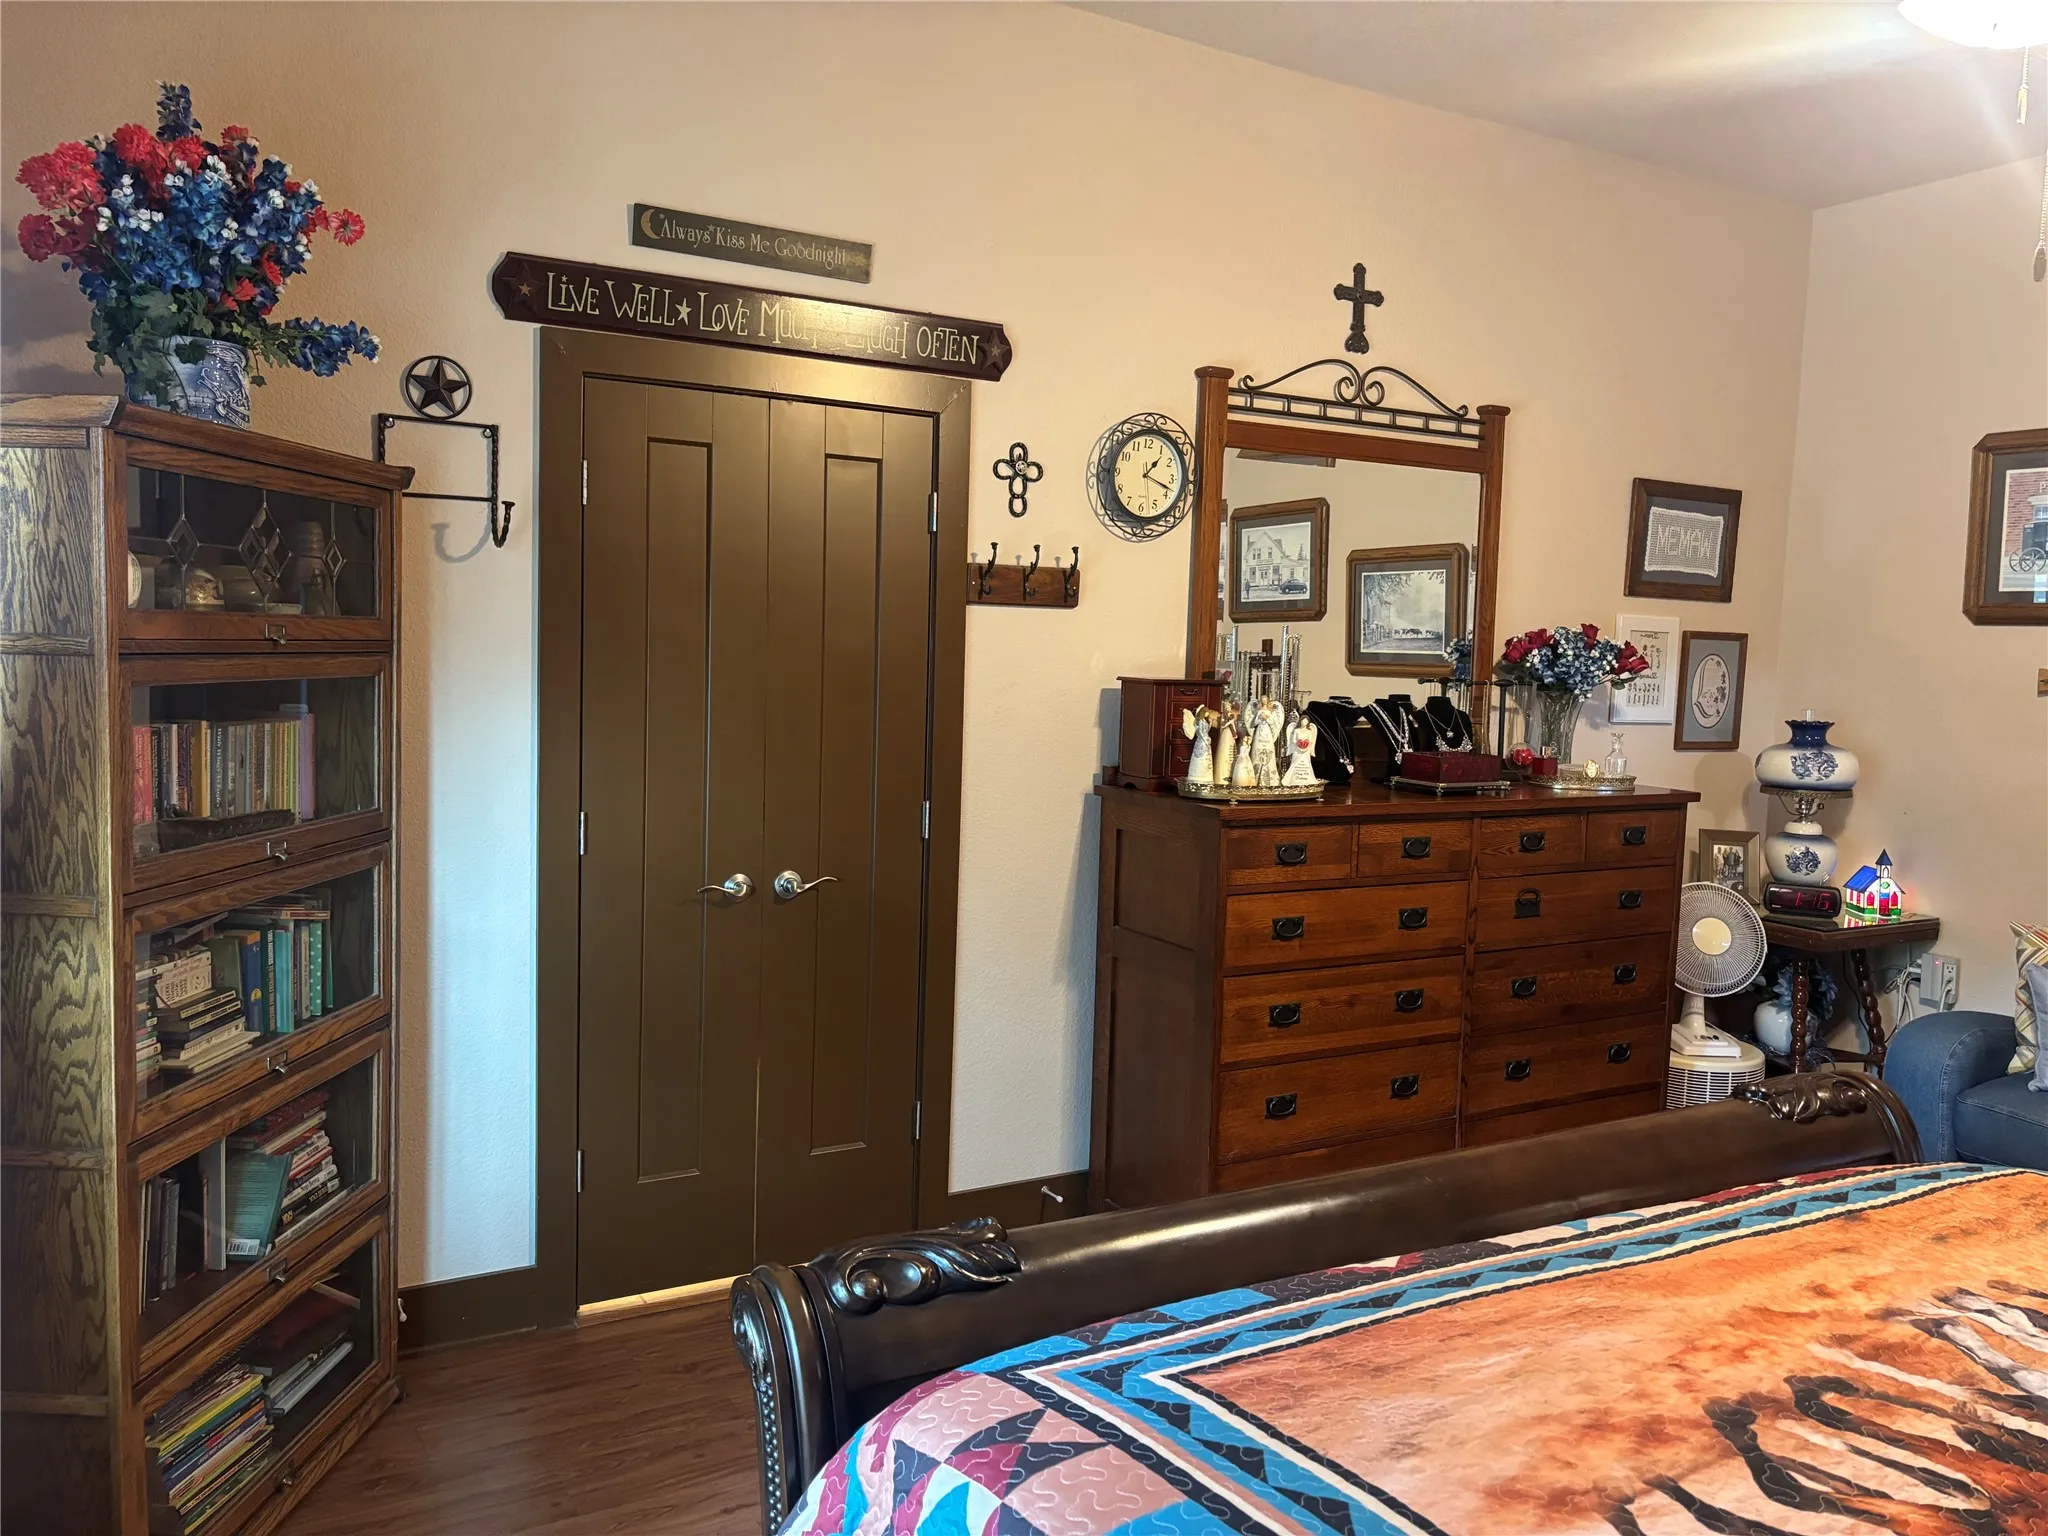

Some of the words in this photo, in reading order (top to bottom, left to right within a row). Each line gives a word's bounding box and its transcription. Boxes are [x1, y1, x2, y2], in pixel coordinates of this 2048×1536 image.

[660, 219, 711, 248] Always
[715, 226, 746, 249] Kiss
[750, 233, 770, 253] Me
[774, 237, 847, 269] Goodnight
[604, 279, 675, 326] WELL
[697, 291, 750, 335] LOVE
[916, 325, 980, 365] OFTEN
[1132, 441, 1140, 452] 11
[1144, 438, 1154, 449] 12
[1121, 451, 1131, 462] 10
[1166, 457, 1172, 468] 2
[1115, 467, 1121, 477] 9
[1168, 474, 1175, 485] 3
[1117, 484, 1123, 494] 8
[1163, 490, 1168, 500] 4
[1126, 496, 1132, 506] 7
[1152, 500, 1158, 510] 5
[1138, 502, 1144, 512] 6
[1656, 524, 1713, 559] MEMAW
